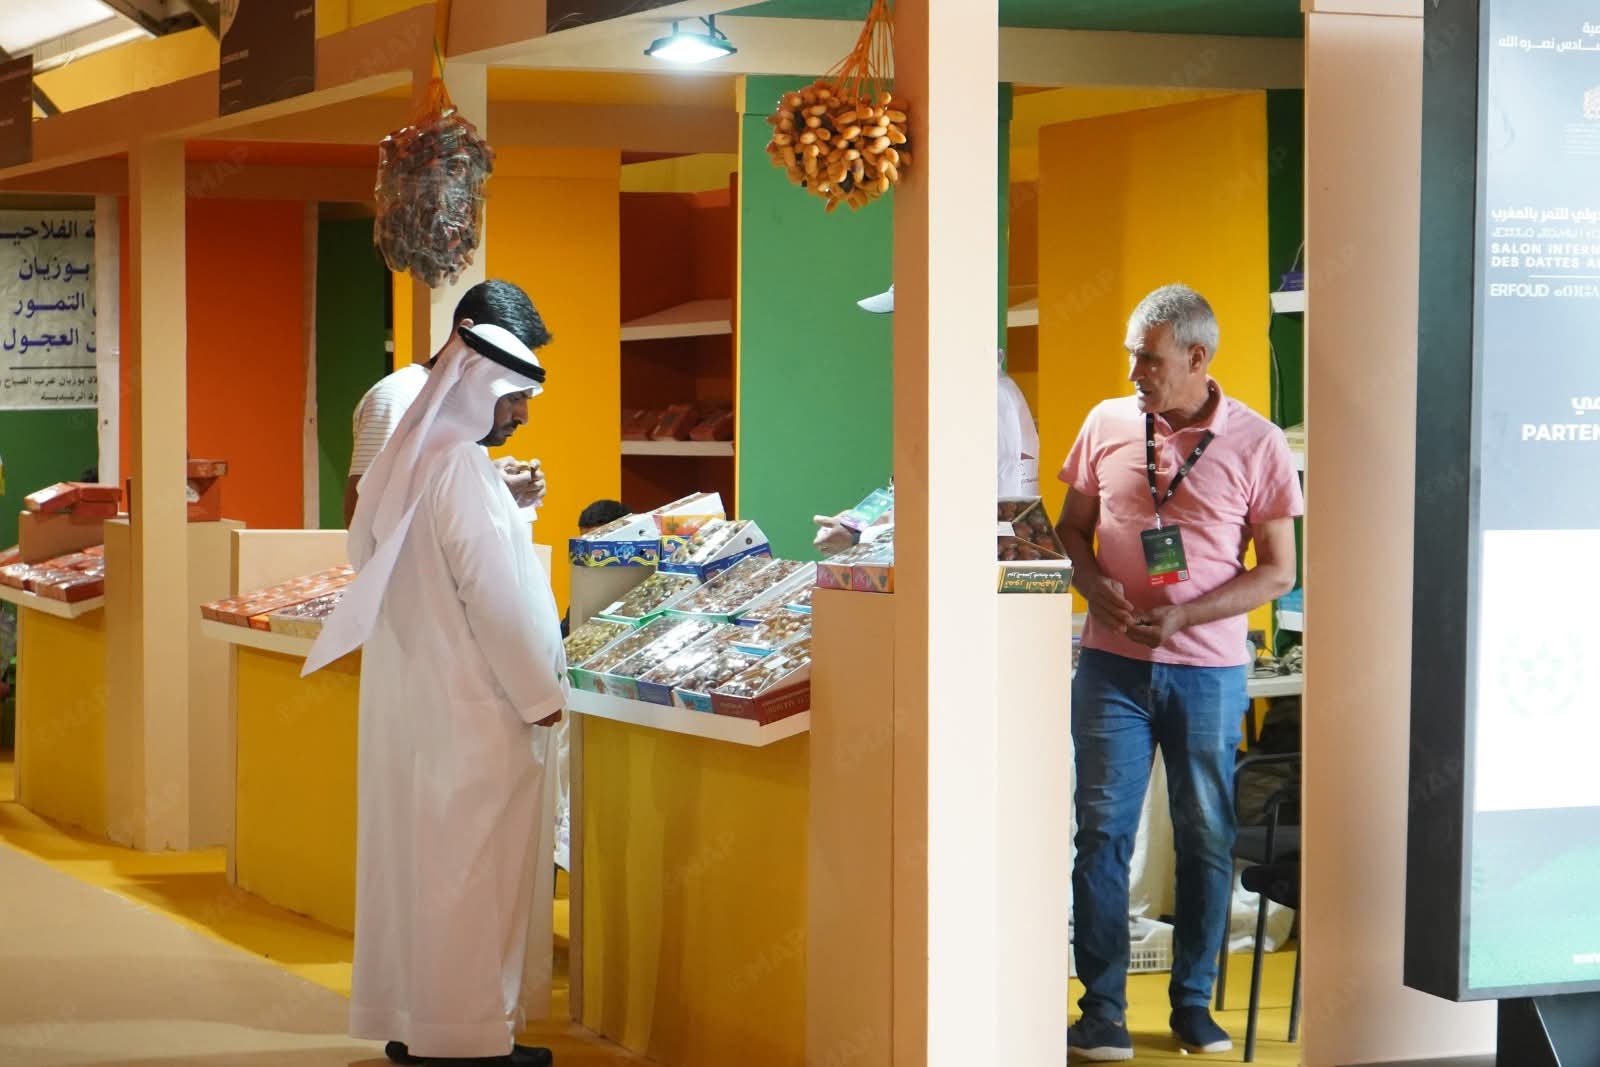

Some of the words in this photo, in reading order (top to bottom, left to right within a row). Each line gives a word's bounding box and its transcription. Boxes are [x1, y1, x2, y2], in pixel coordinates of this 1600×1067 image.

[1498, 35, 1518, 48] الله
[1491, 243, 1542, 254] SALON
[1491, 256, 1520, 268] DES
[1525, 256, 1579, 268] DATTES
[1490, 283, 1549, 297] ERFOUD
[14, 292, 85, 318] التمور
[3, 328, 79, 354] العجول
